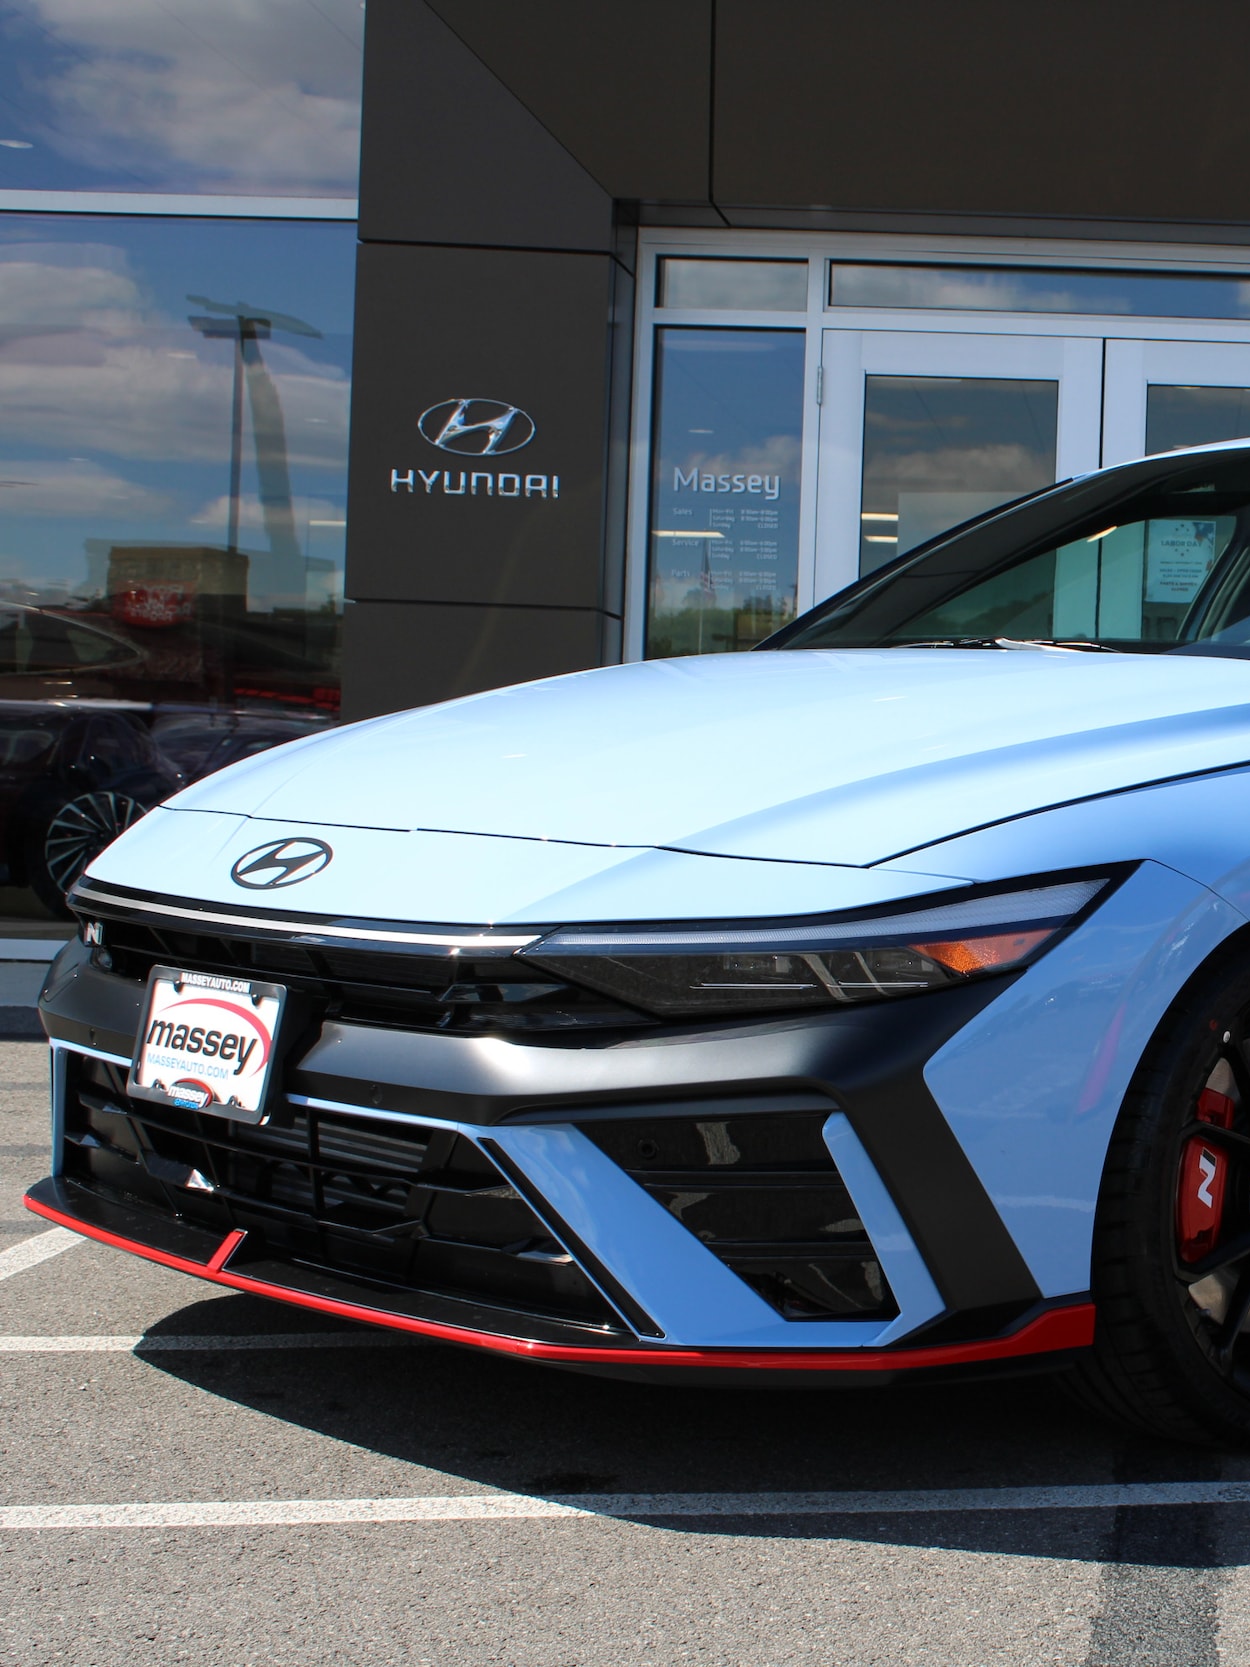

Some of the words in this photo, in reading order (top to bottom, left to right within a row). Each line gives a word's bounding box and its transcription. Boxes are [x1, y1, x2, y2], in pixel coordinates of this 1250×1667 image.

[391, 469, 560, 499] HYUNDAI
[674, 466, 780, 500] Massey
[673, 507, 693, 516] Sales
[672, 539, 699, 547] Service
[671, 569, 690, 577] Parts
[87, 922, 103, 945] N
[181, 972, 250, 993] MASSEYAUTO.COM
[146, 1019, 258, 1076] massey
[146, 1052, 229, 1080] MASSEYAUTO.COM
[167, 1086, 209, 1108] massey
